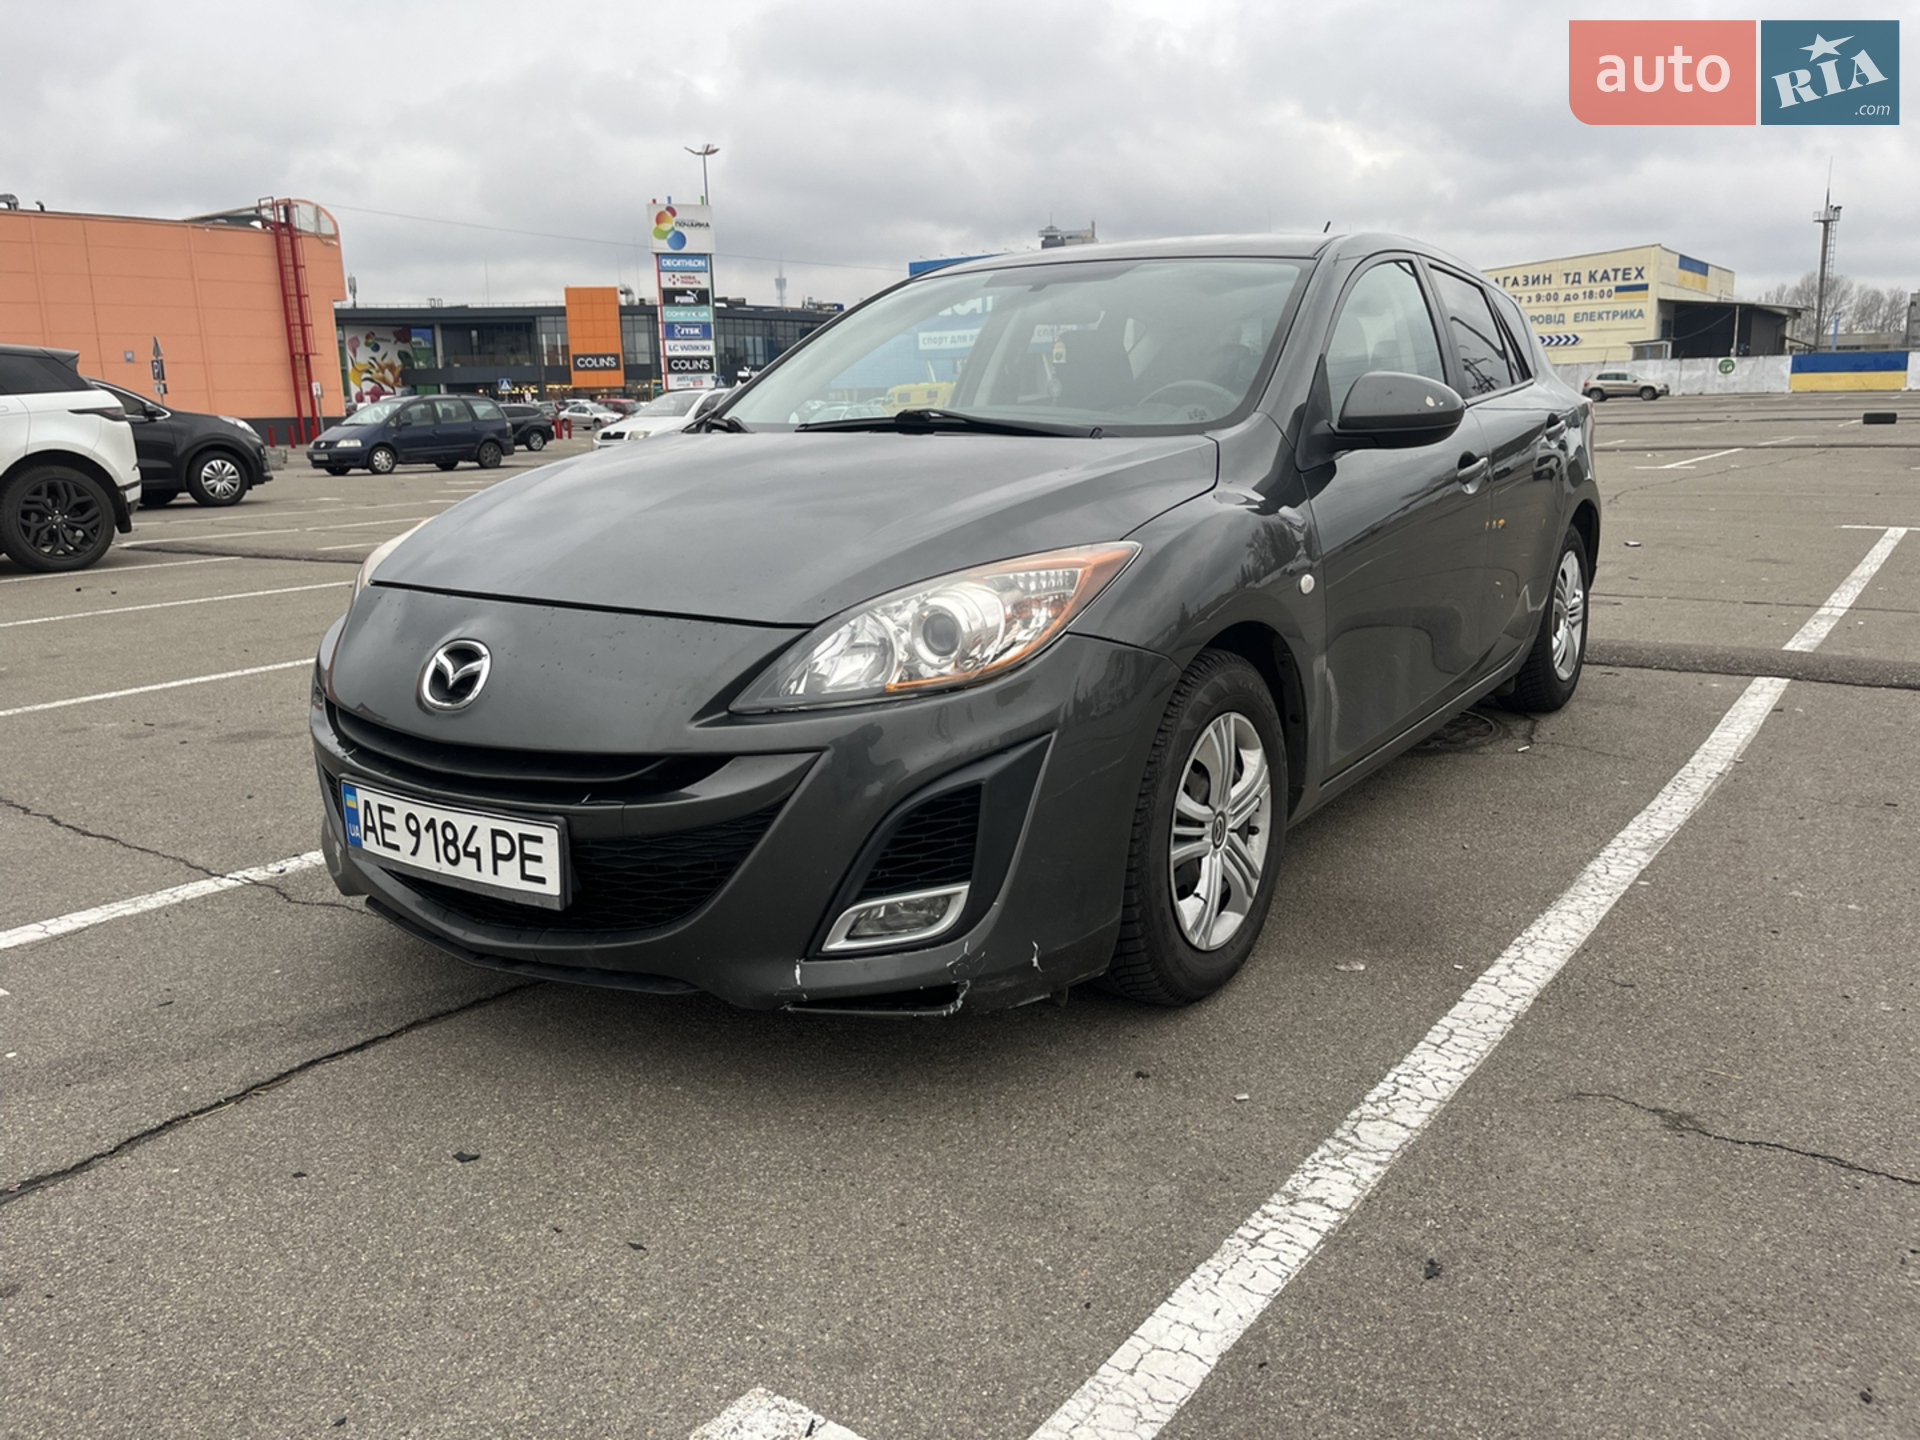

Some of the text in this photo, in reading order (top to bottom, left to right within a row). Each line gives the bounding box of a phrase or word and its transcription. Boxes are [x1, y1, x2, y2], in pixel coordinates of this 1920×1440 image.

[662, 258, 706, 267] DECATHLON
[1563, 271, 1582, 286] ТД
[1588, 266, 1645, 284] КАТЕХ
[1535, 291, 1559, 303] 9:00
[1563, 293, 1579, 303] до
[1582, 288, 1613, 300] 18:00
[1573, 308, 1645, 323] ЕЛЕКТРИКА
[950, 334, 967, 345] для
[577, 357, 616, 368] COLIN'S
[671, 359, 710, 370] COLIN'S
[349, 823, 361, 838] UA
[363, 799, 547, 885] AE 9184 PE
